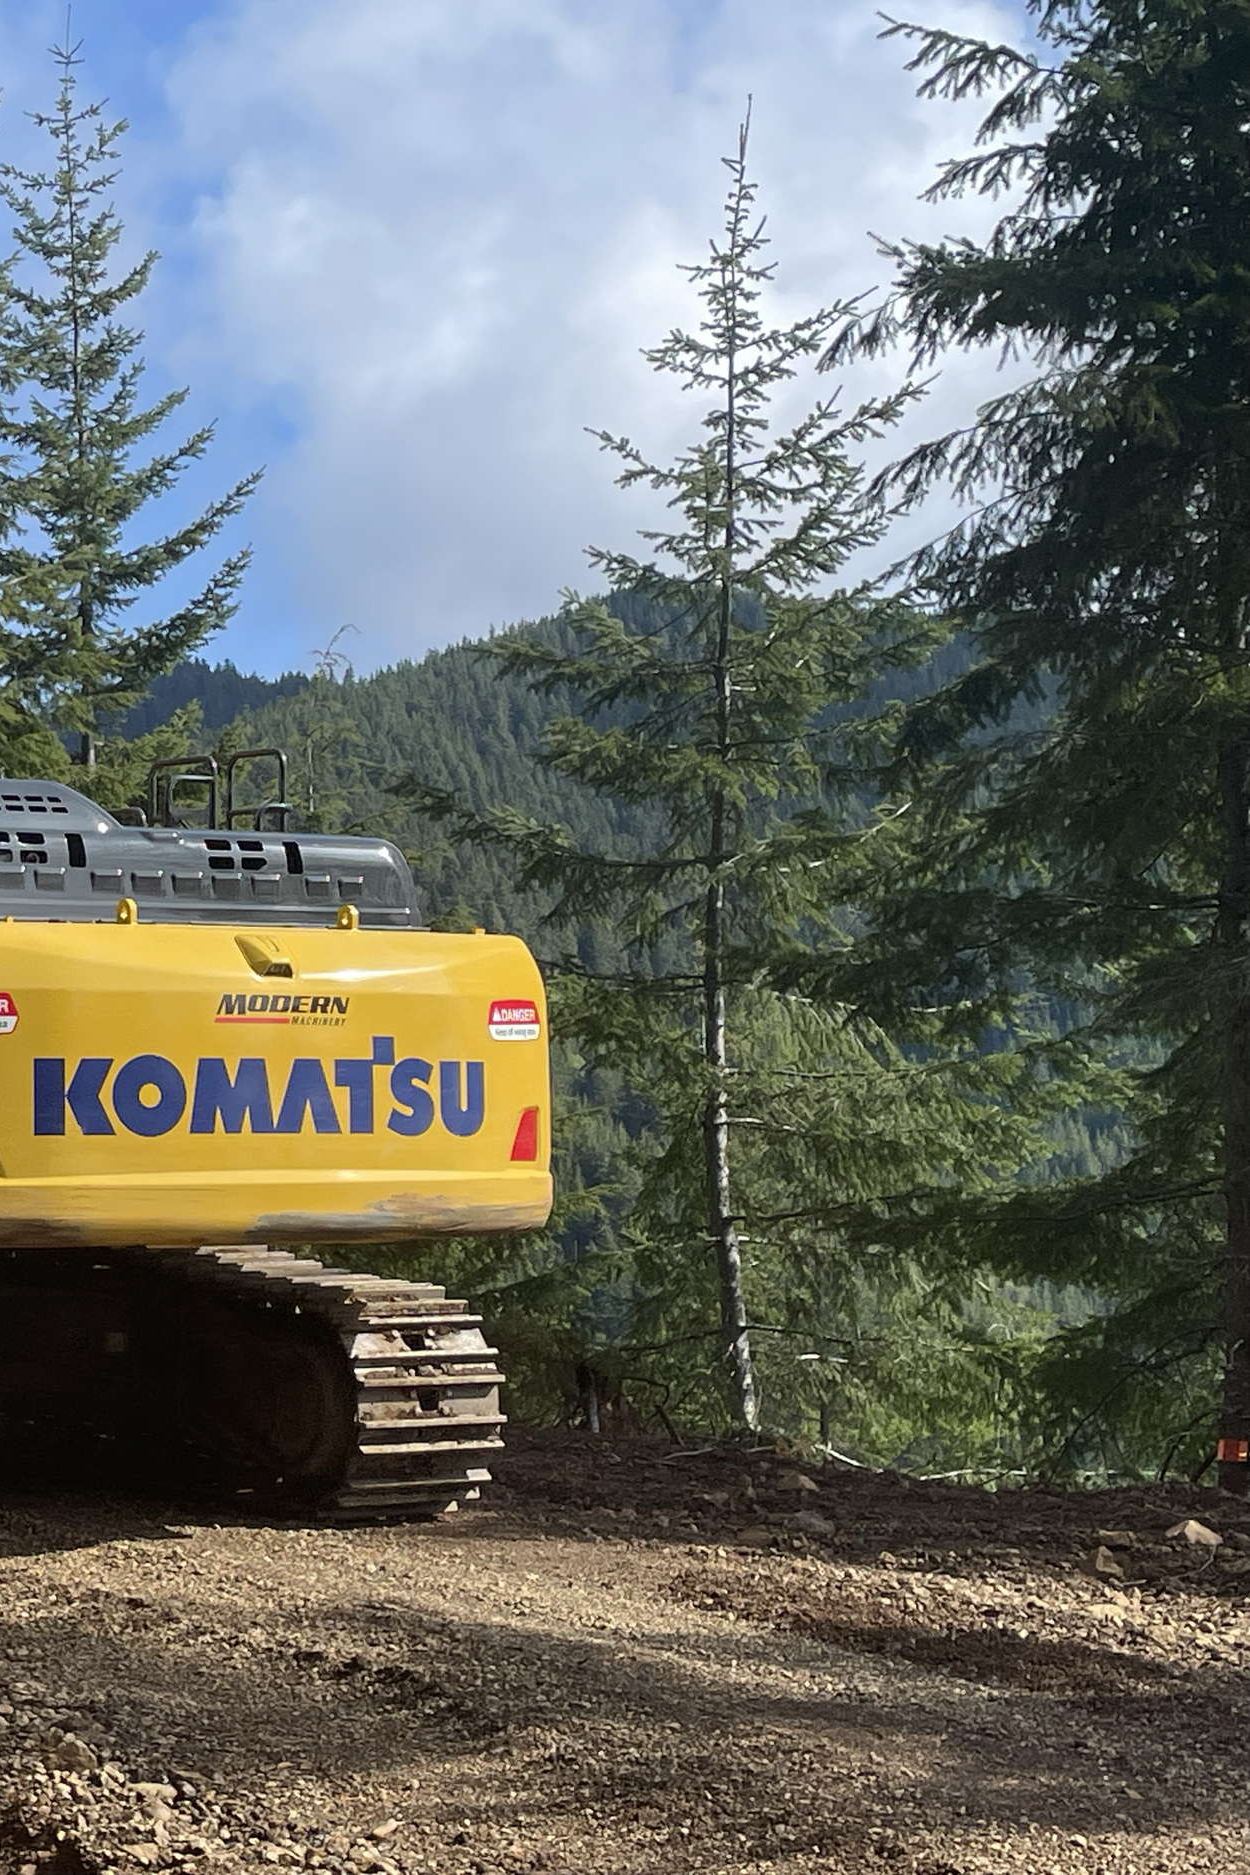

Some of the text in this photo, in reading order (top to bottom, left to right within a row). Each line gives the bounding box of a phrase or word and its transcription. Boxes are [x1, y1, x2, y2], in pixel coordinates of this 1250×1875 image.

[216, 994, 350, 1015] MODERN
[291, 1016, 347, 1026] MACHINERY
[501, 1008, 536, 1021] DANGER
[33, 1035, 485, 1137] KOMATSU
